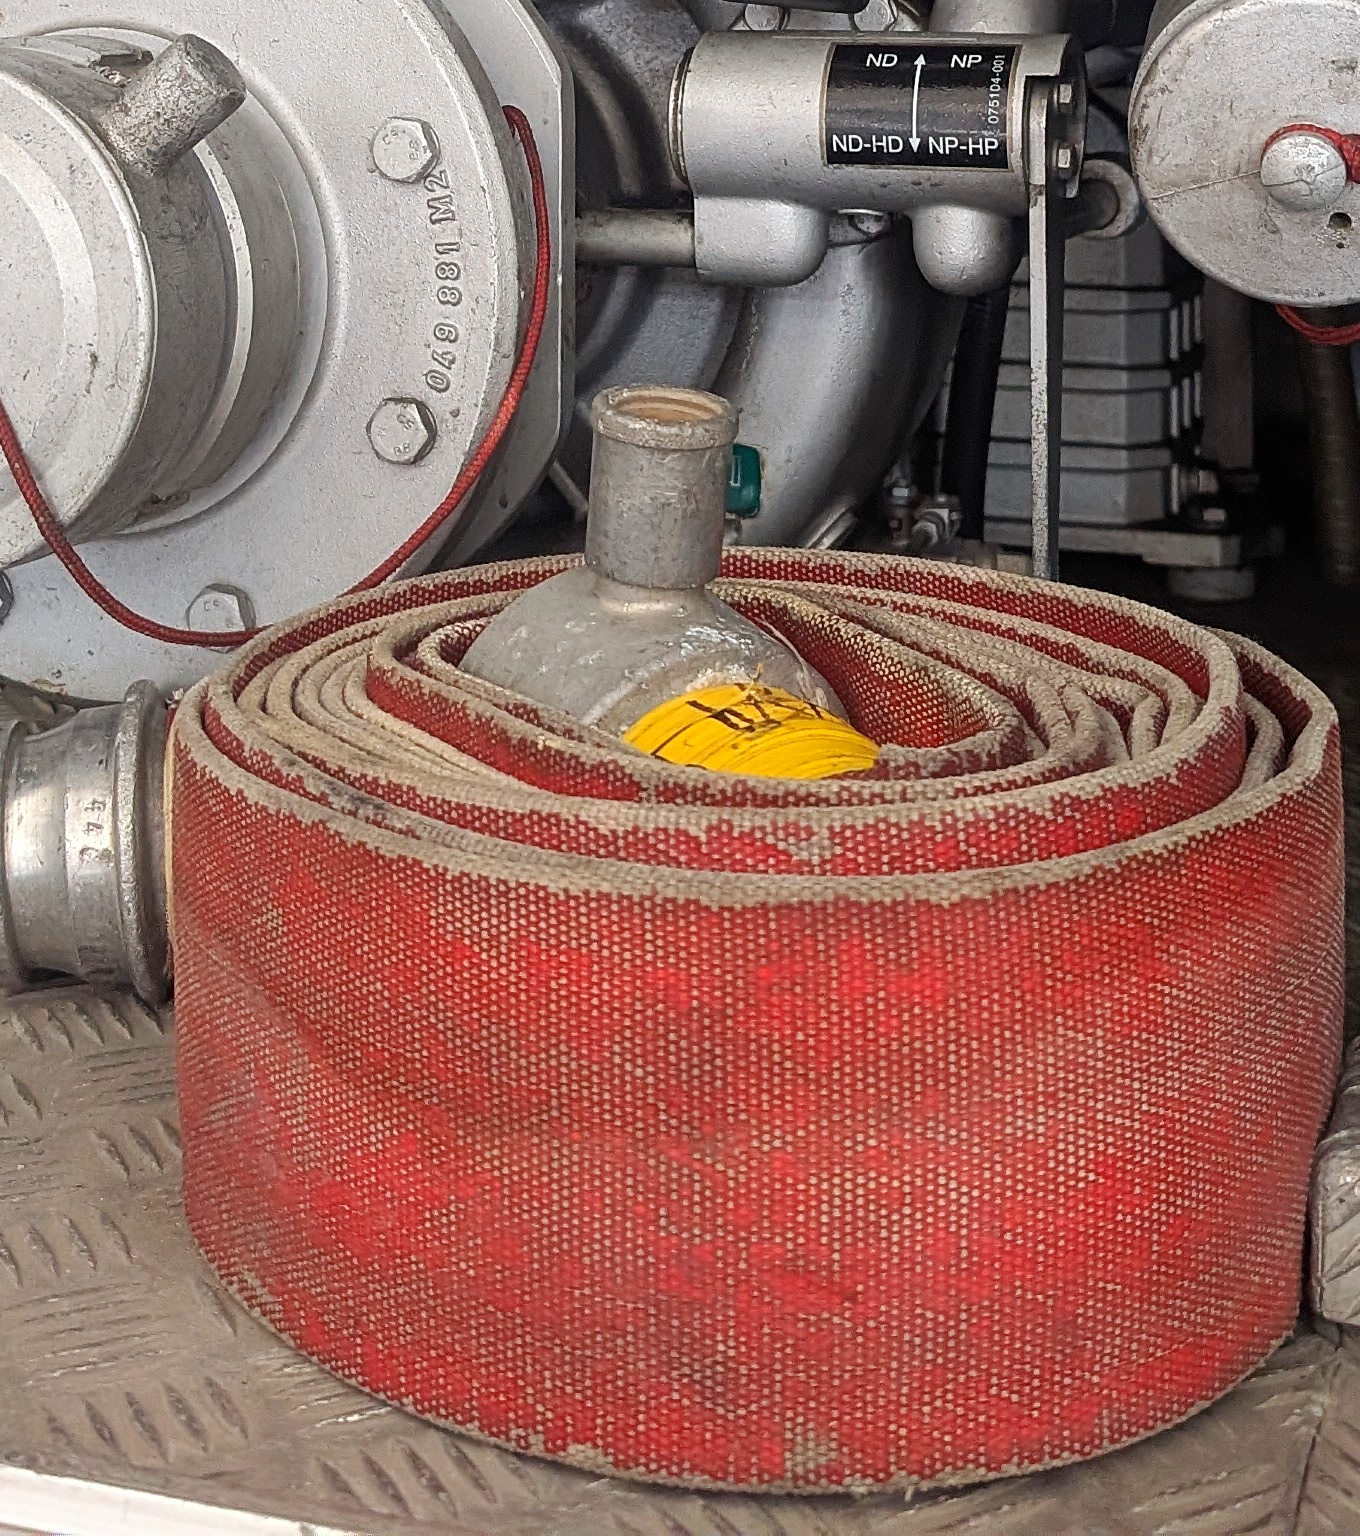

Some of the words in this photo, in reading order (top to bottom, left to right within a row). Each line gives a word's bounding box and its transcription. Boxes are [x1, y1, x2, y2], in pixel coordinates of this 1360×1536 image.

[865, 52, 899, 68] ND
[950, 53, 983, 69] NP
[987, 54, 1006, 125] 075104-001
[831, 134, 904, 154] ND-HD
[928, 136, 999, 156] NP-HP
